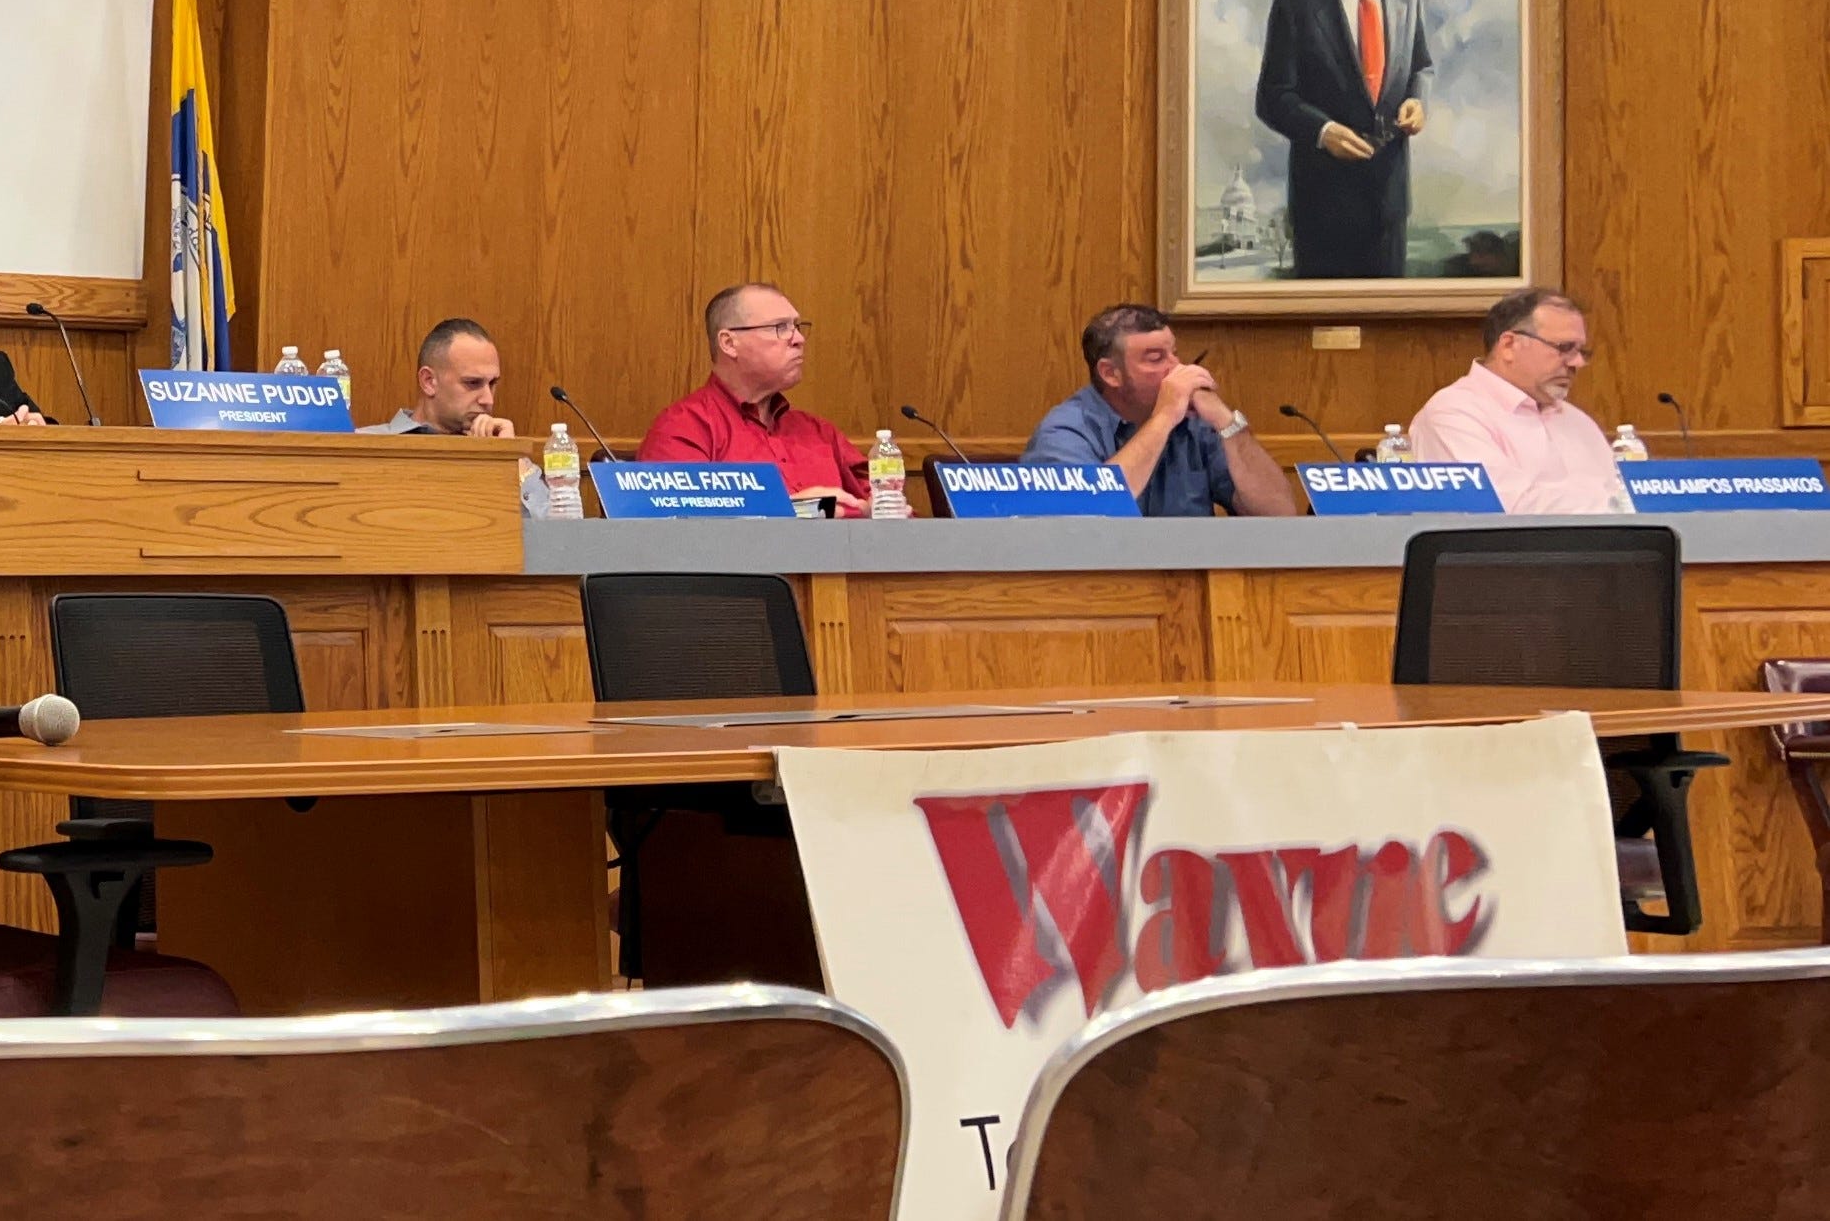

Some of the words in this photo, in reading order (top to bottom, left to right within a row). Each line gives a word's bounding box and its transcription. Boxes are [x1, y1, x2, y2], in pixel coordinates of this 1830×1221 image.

[148, 380, 260, 404] SUZANNE
[261, 383, 339, 407] PUDUP
[218, 410, 287, 423] PRESIDENT
[615, 471, 700, 491] MICHAEL
[698, 471, 766, 491] FATTAL
[942, 467, 1019, 492] DONALD
[1017, 466, 1098, 496] PAVLAK,
[1096, 466, 1125, 492] JR.
[1305, 466, 1389, 492] SEAN
[1389, 466, 1484, 491] DUFFY
[1629, 478, 1733, 495] HARALAMPOS
[1731, 476, 1824, 494] PRASSAKOS
[650, 496, 681, 508] VICE
[681, 496, 746, 508] PRESIDENT
